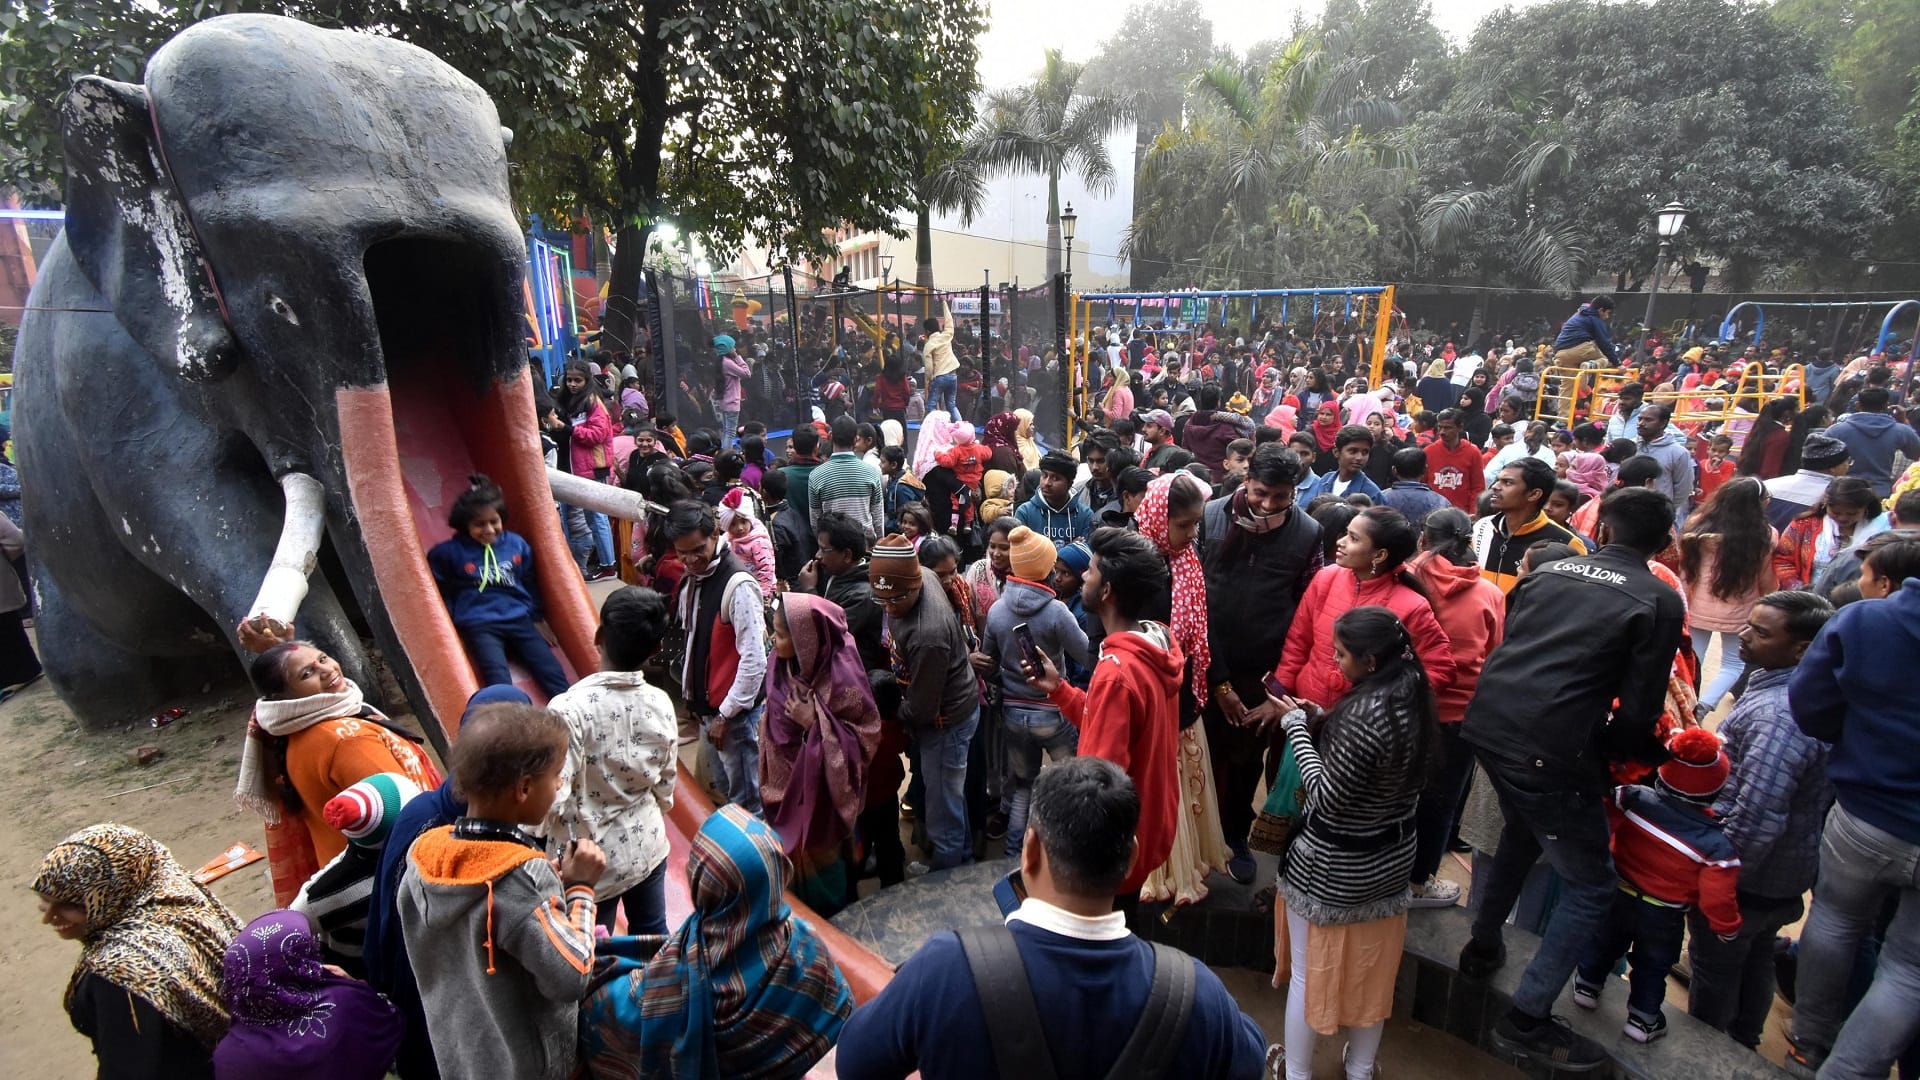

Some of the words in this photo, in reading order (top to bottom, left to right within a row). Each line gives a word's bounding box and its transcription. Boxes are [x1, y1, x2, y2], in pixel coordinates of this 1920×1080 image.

[1043, 526, 1076, 538] GUCCI
[1475, 519, 1488, 556] UPERD
[1553, 561, 1627, 585] COOLZONE
